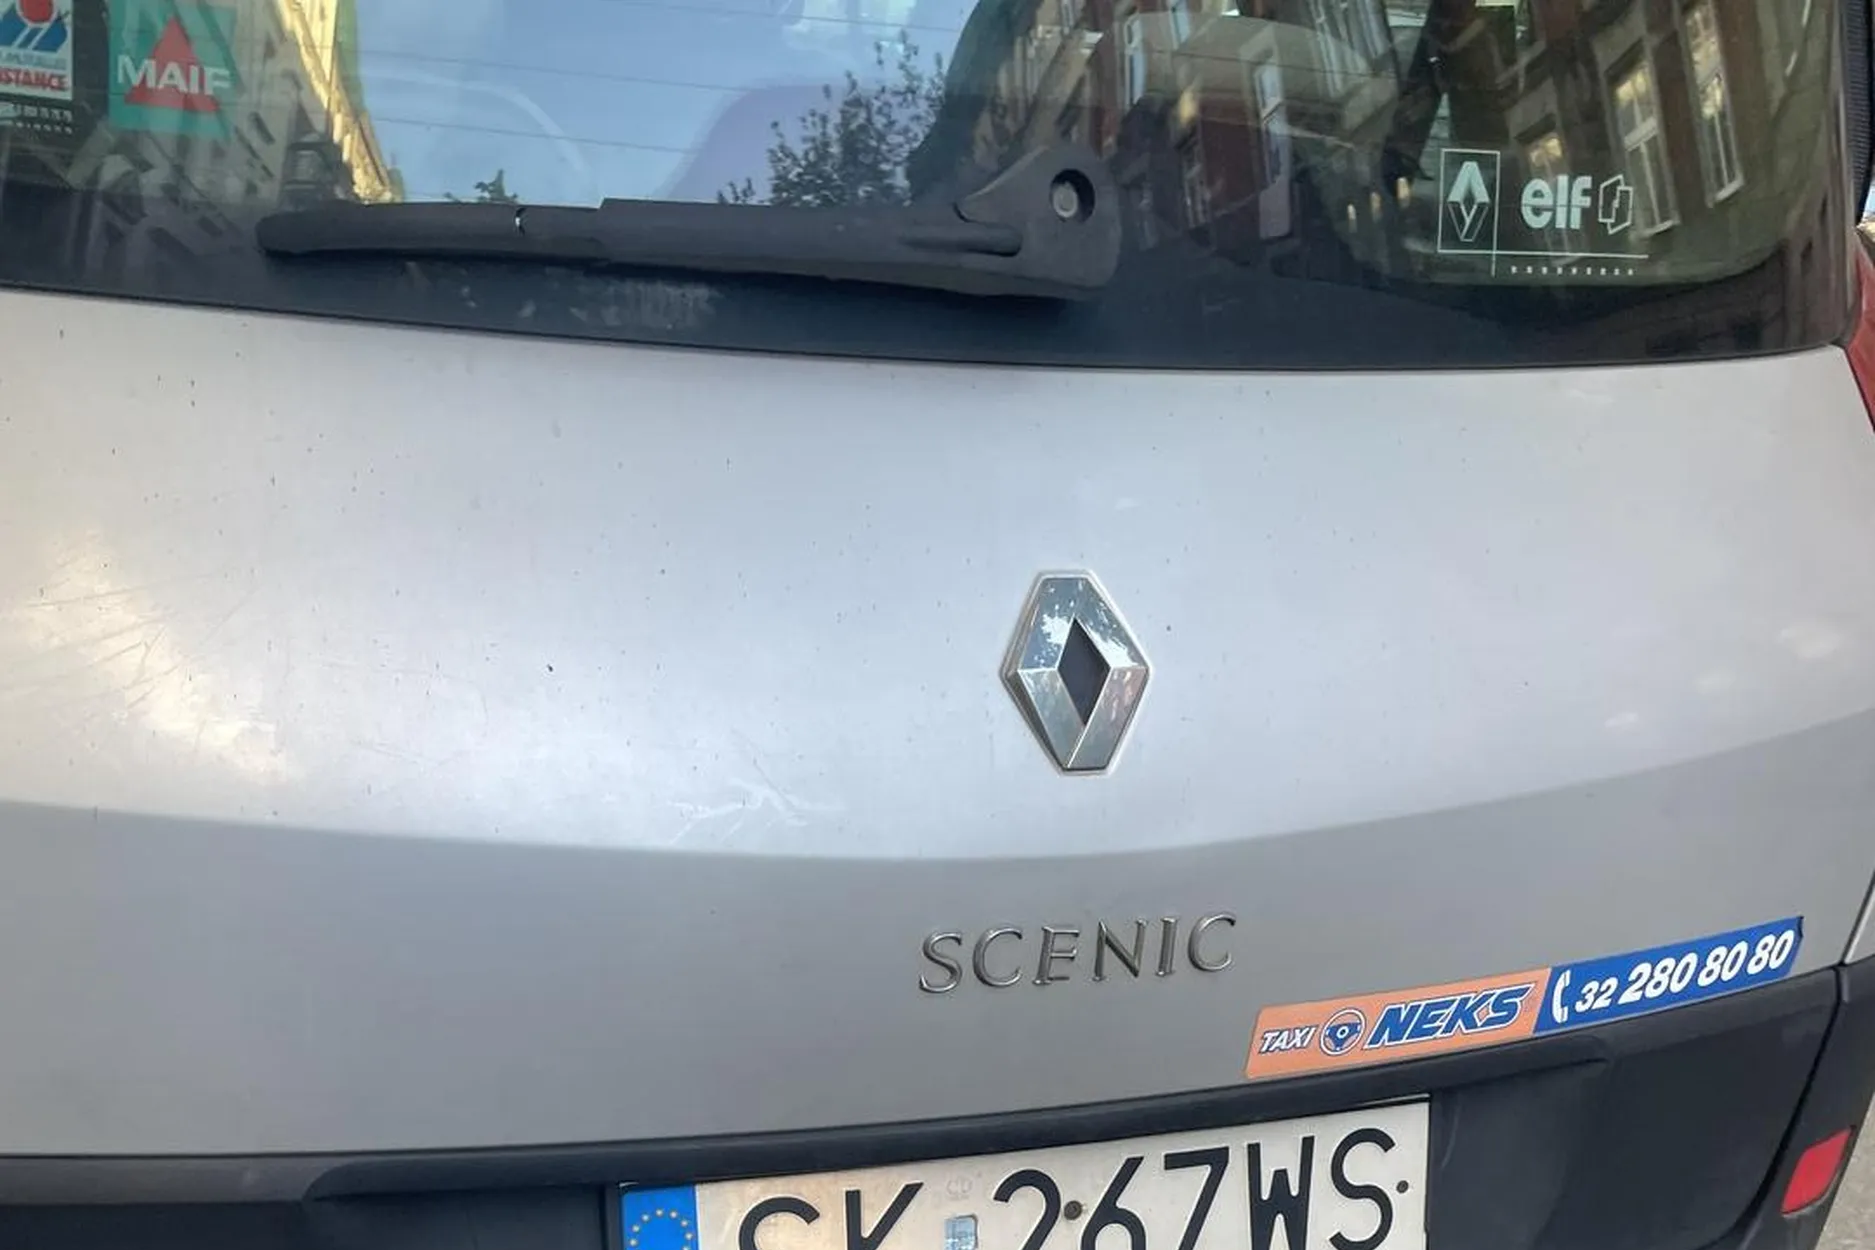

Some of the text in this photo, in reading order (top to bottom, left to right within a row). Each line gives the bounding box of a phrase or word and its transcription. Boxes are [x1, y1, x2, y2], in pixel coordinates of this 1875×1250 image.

[116, 54, 232, 96] MAIF
[1520, 173, 1593, 230] elf
[918, 911, 1237, 994] SCENIC
[1257, 929, 1796, 1055] TAXI NEKS 32 280 80 80
